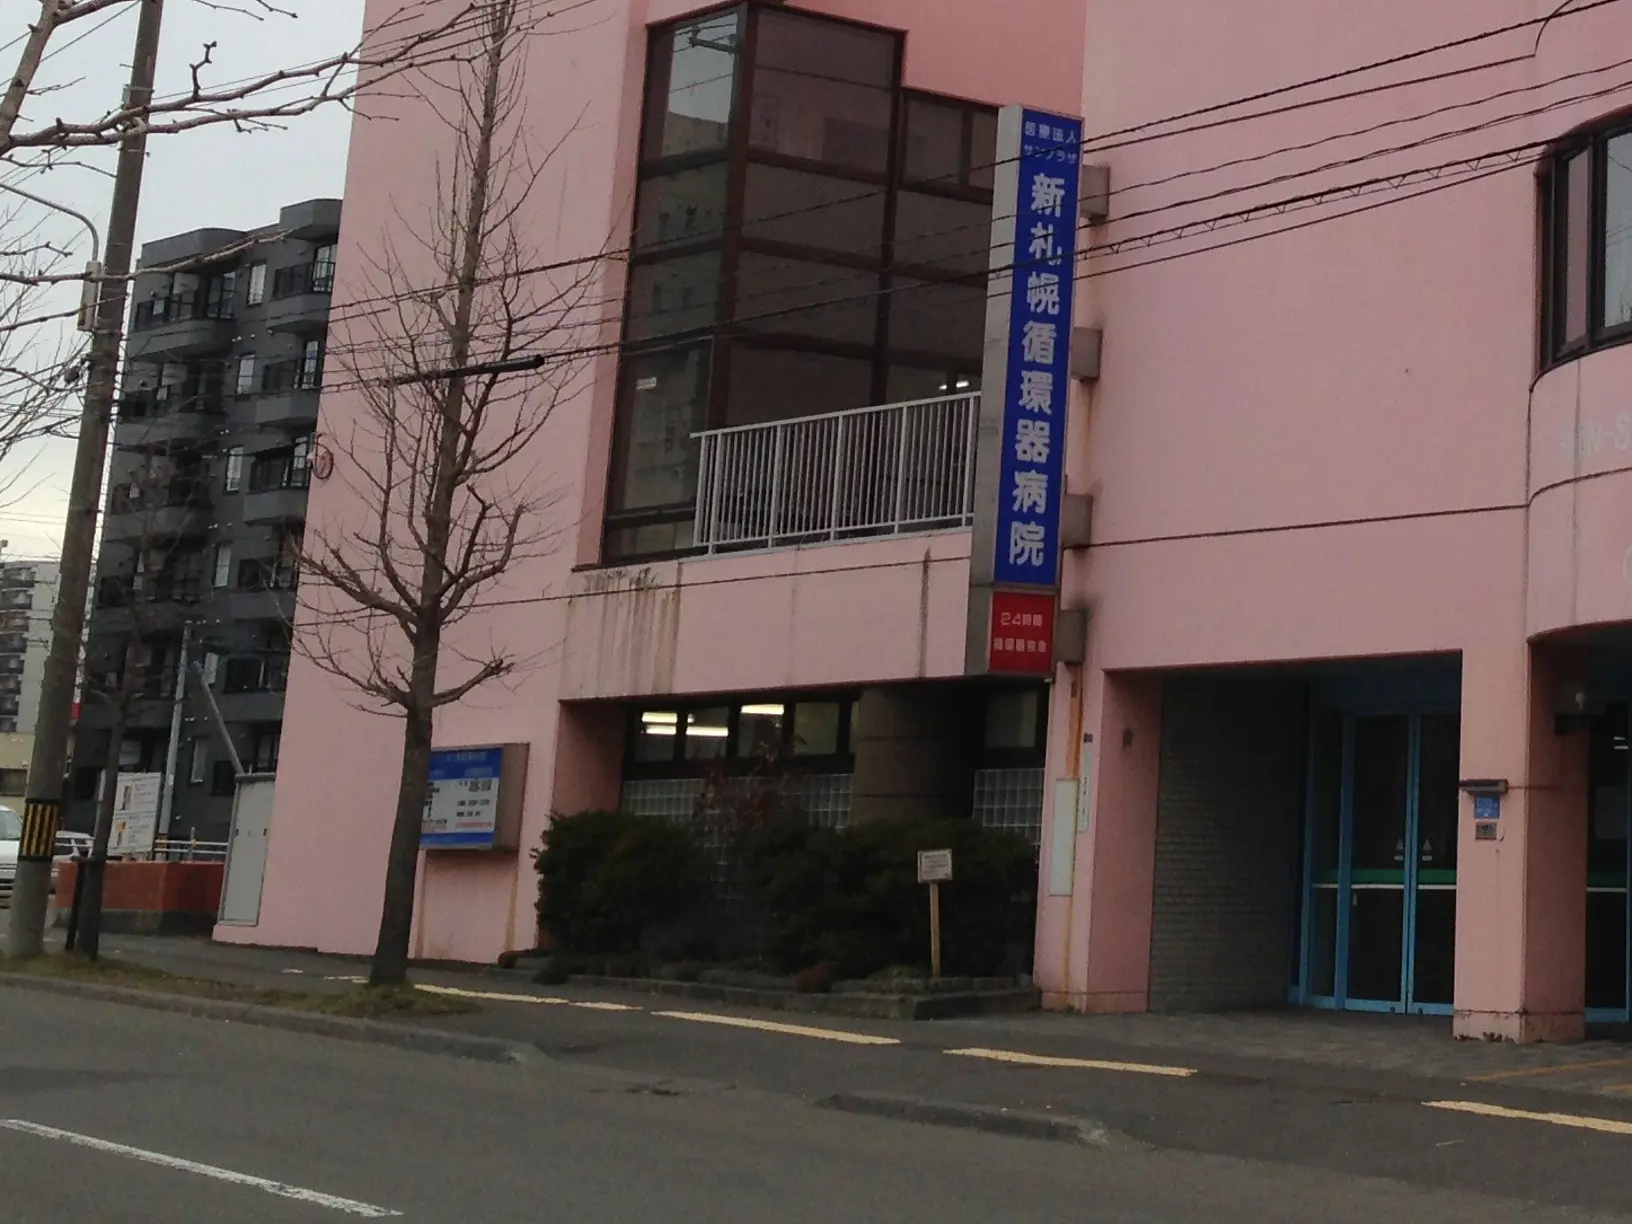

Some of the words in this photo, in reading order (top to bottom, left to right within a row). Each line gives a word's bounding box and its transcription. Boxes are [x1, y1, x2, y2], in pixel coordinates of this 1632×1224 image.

[1009, 172, 1066, 568] 新札幌循環器病院
